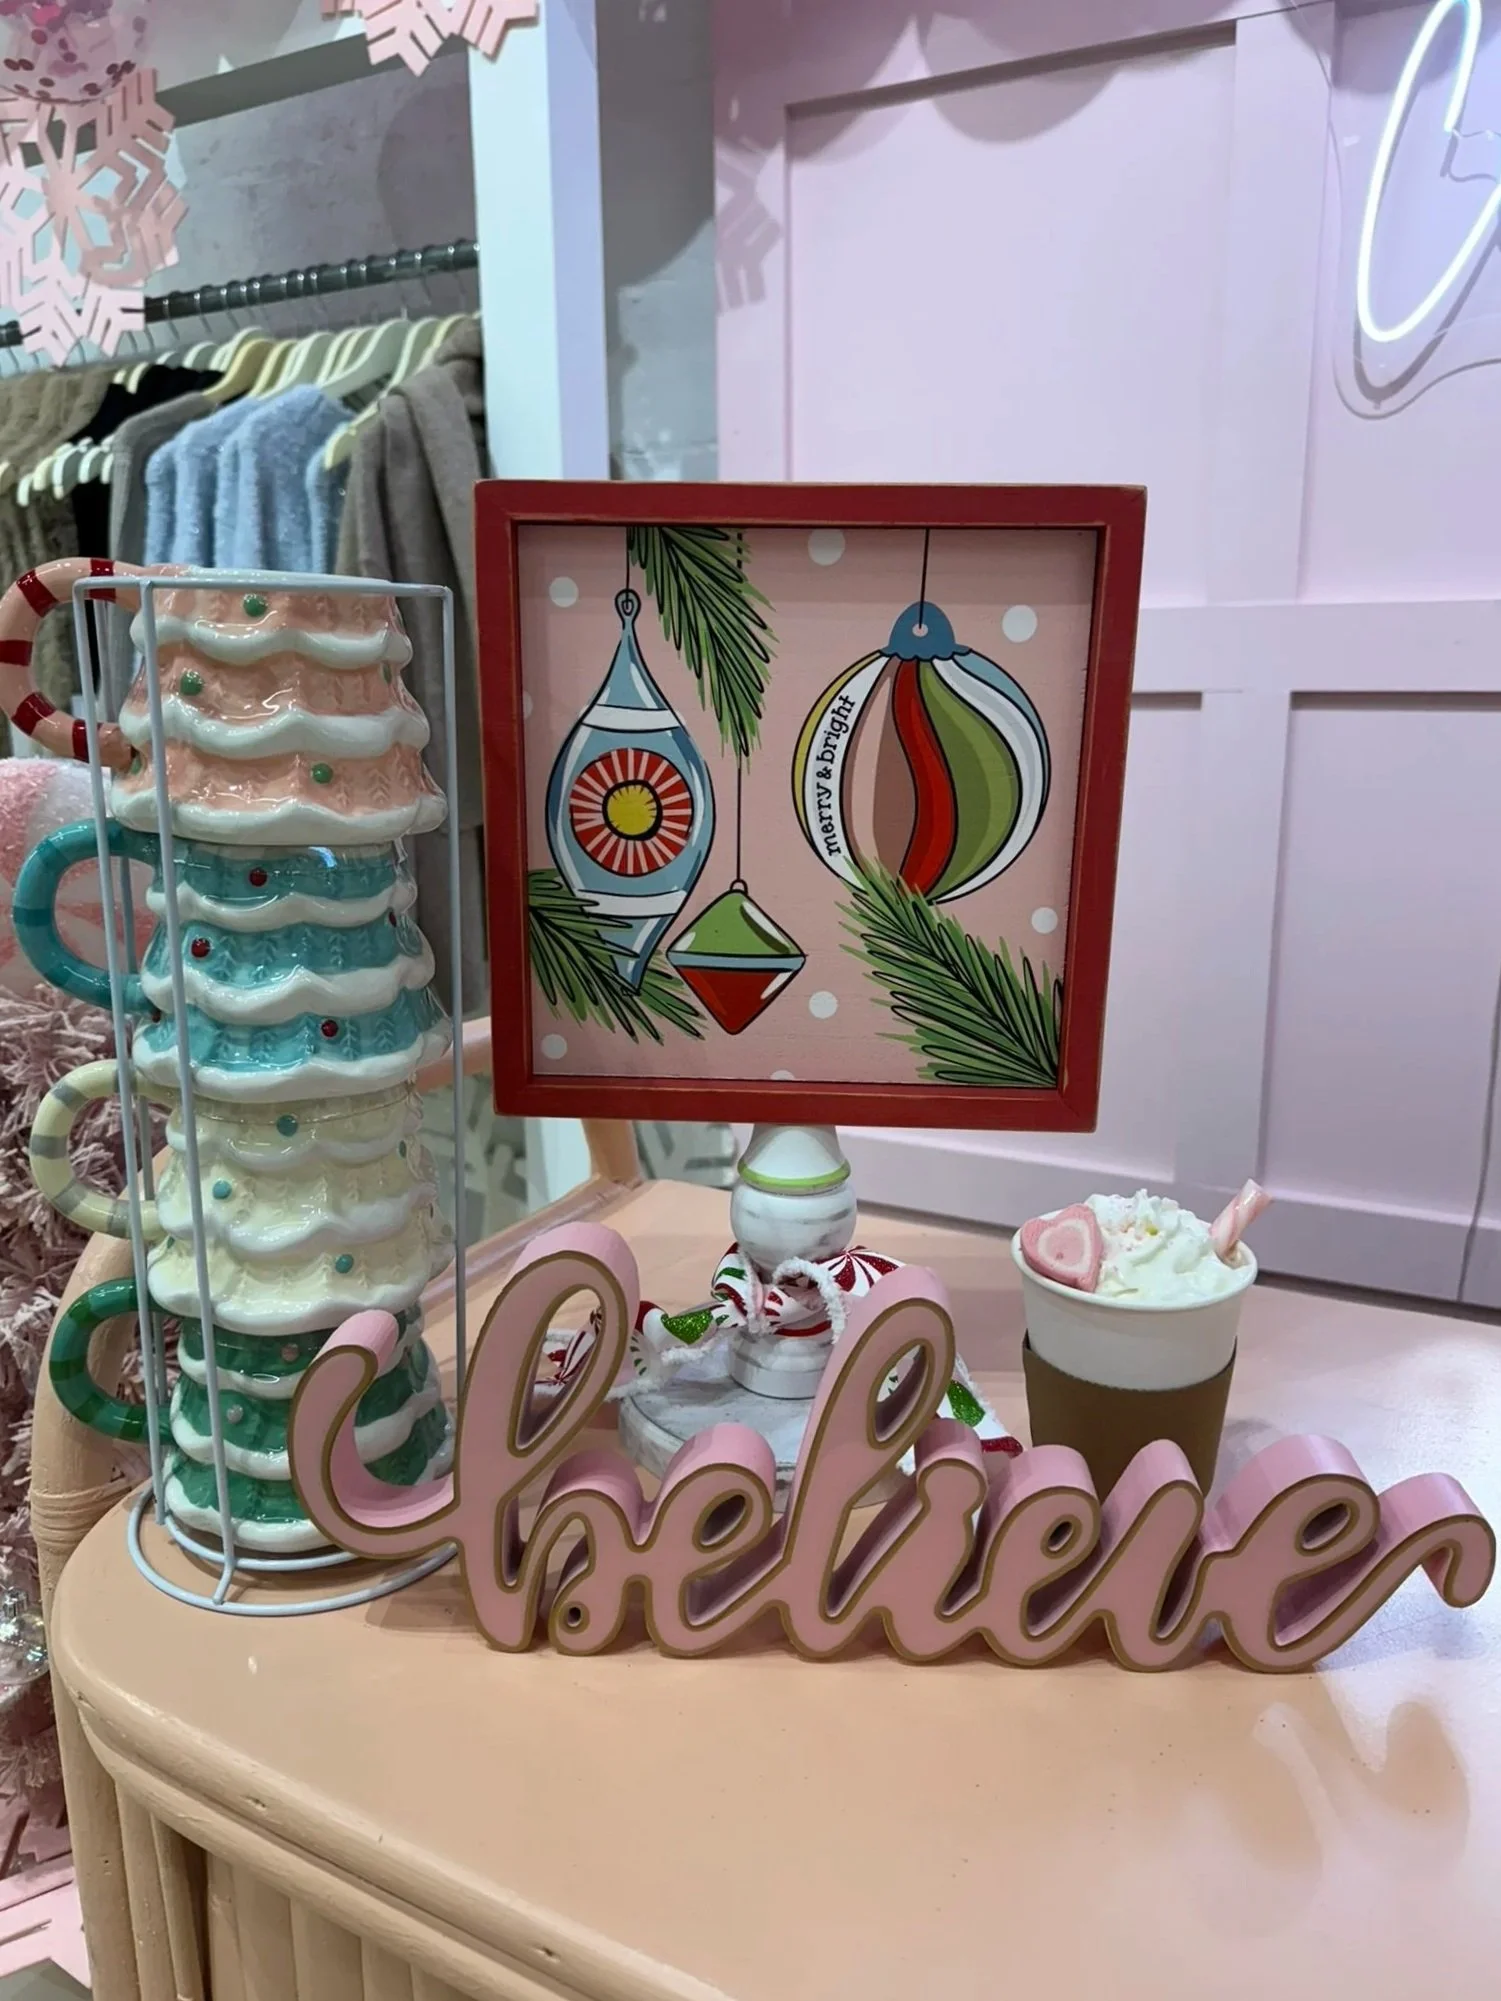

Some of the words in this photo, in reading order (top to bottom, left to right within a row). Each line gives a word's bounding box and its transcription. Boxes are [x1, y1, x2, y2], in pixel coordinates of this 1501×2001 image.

[815, 694, 856, 765] bright
[815, 765, 833, 781] &
[816, 782, 842, 857] merry
[287, 1223, 1497, 1675] believe
